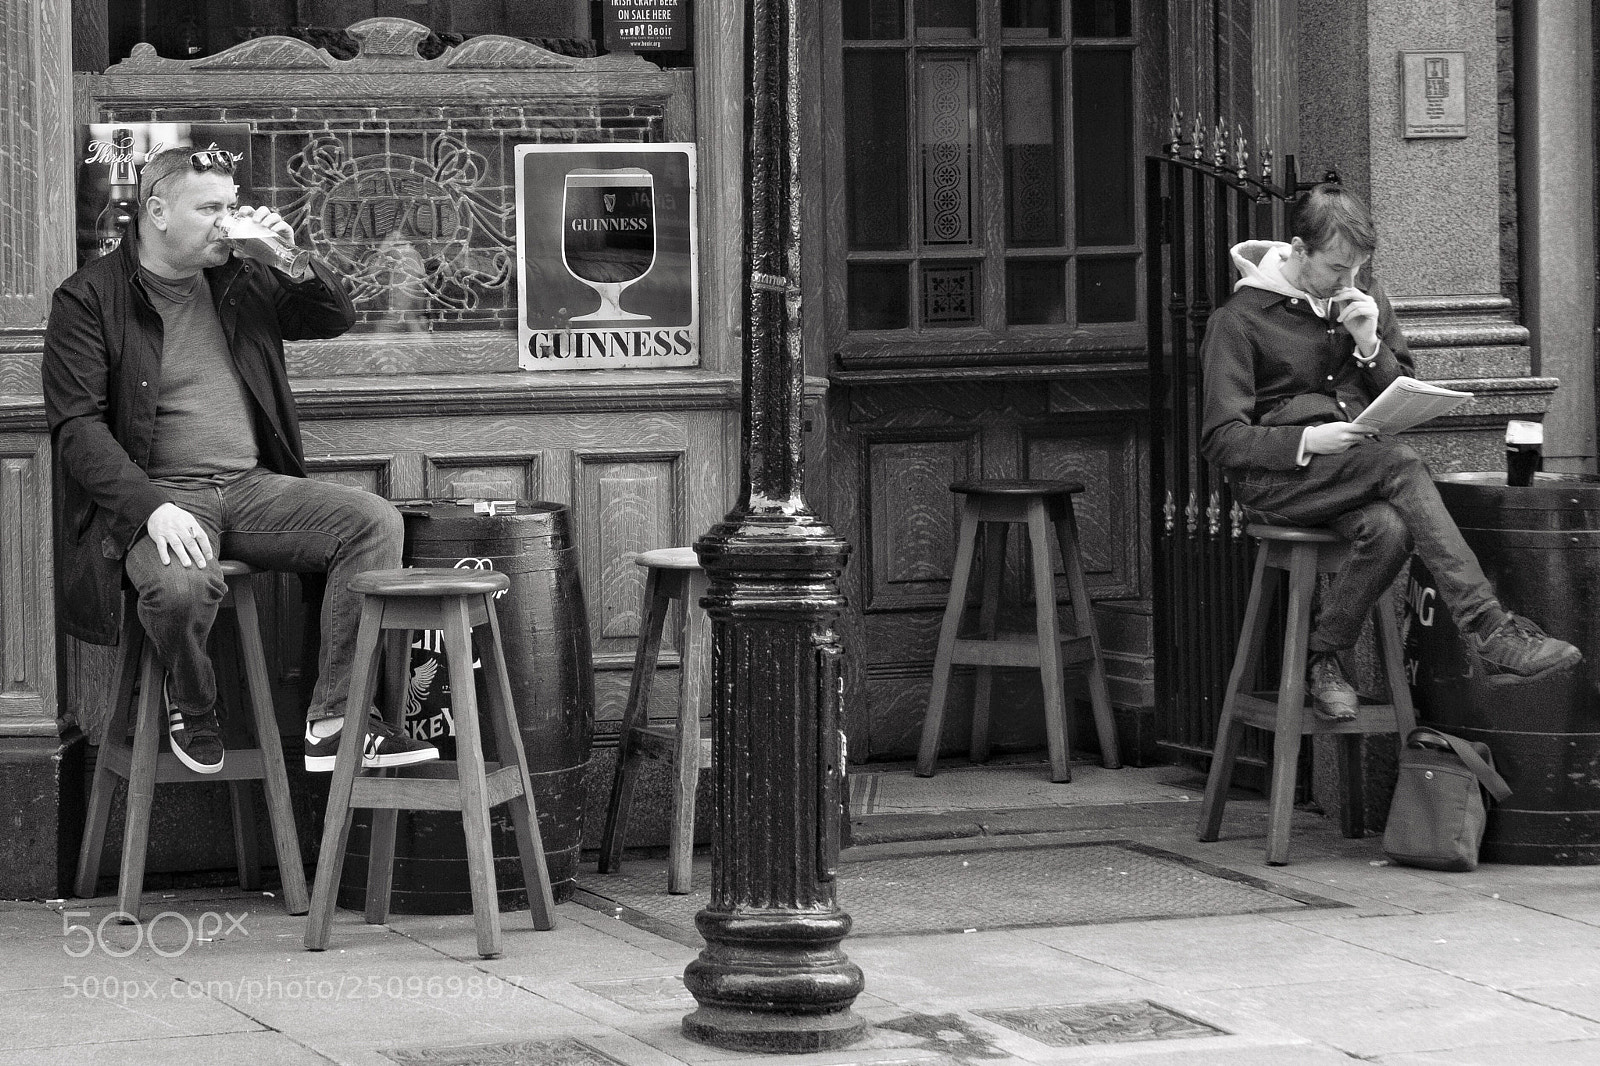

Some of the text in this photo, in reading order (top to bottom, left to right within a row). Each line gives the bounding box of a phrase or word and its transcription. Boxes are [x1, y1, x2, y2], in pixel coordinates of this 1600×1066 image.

[618, 9, 671, 20] ON SALE HERE
[647, 24, 672, 36] Beoir
[85, 137, 135, 164] Three
[571, 217, 648, 232] GUINNESS
[528, 329, 692, 359] GUINNESS
